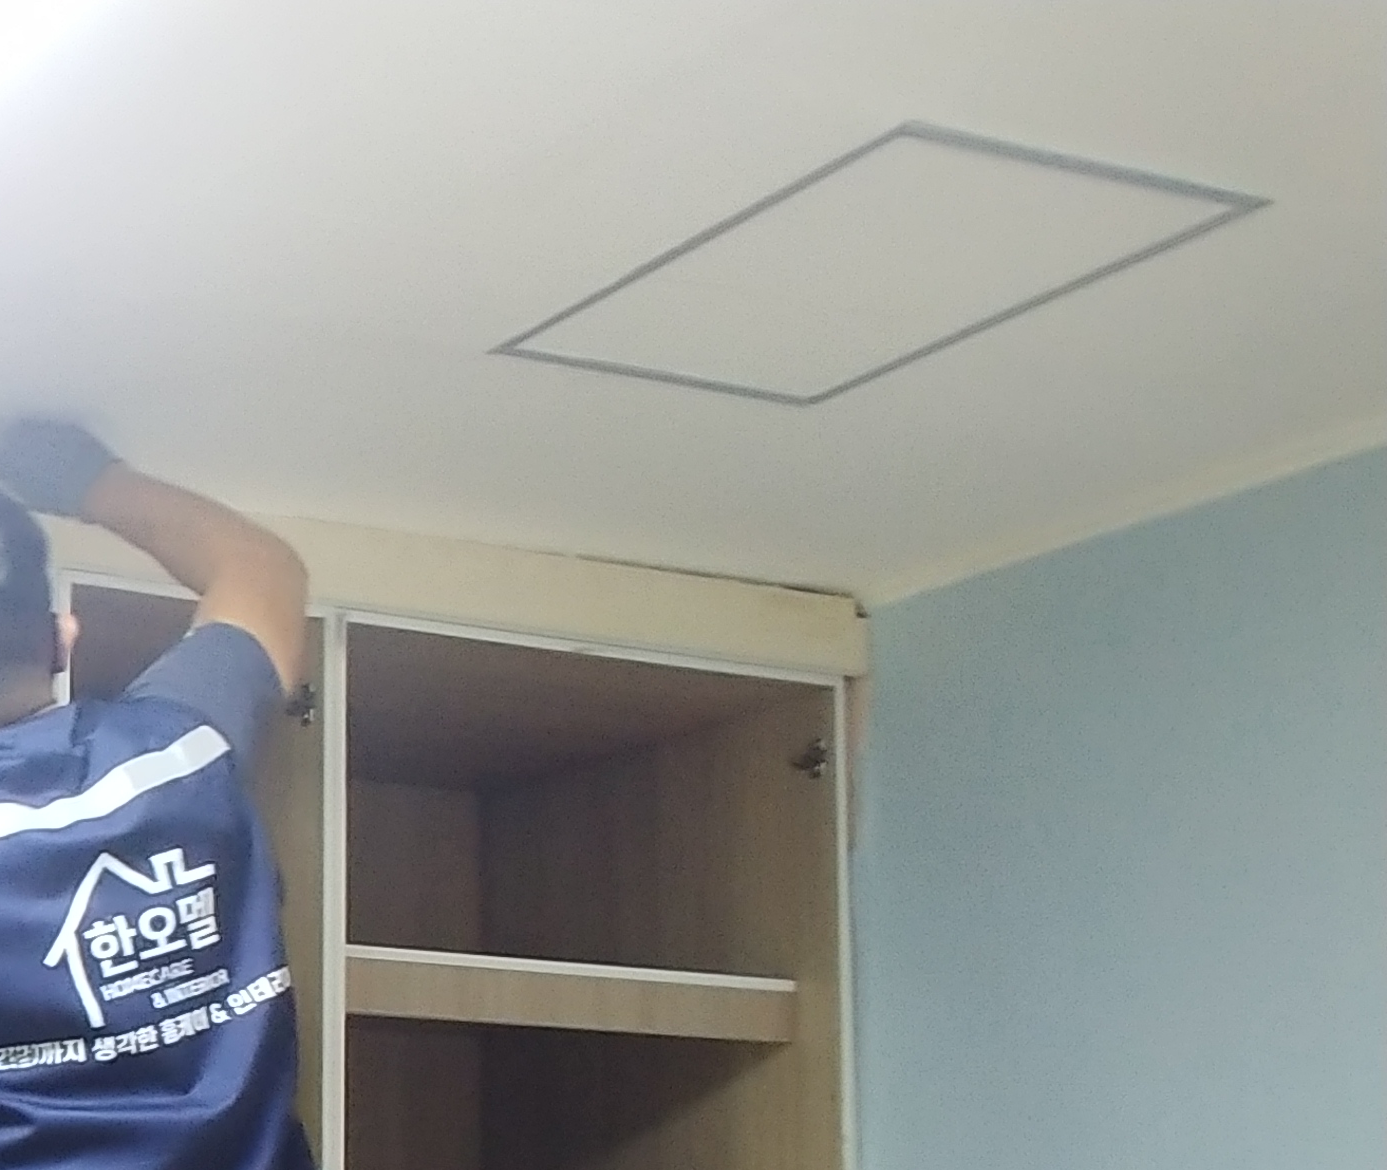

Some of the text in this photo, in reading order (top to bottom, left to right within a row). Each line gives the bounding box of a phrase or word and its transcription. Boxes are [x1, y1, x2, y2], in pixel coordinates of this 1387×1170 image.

[83, 887, 221, 978] 한오멜
[99, 958, 194, 1001] HOMECARE
[92, 1025, 160, 1061] 생각한
[209, 1003, 232, 1023] &
